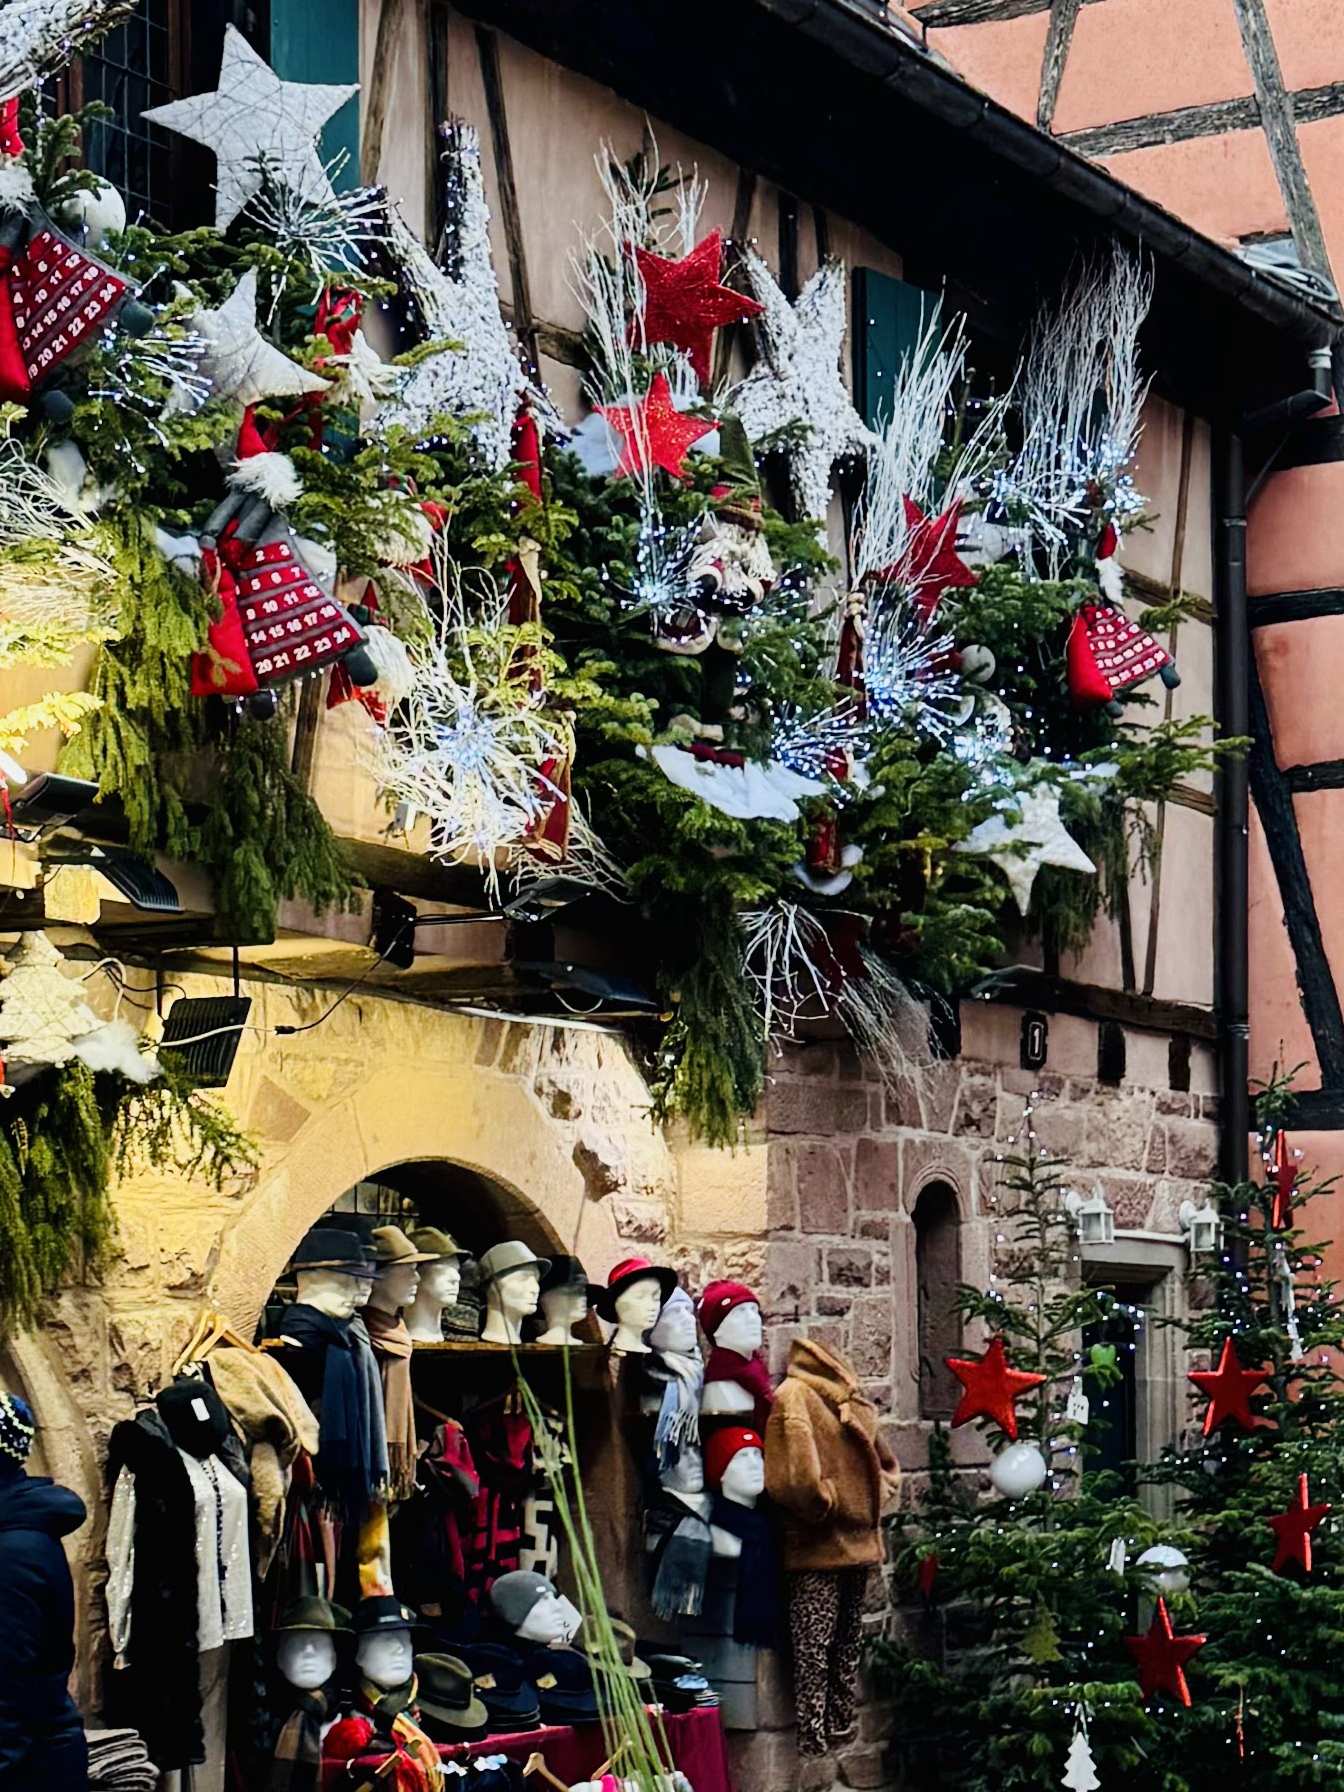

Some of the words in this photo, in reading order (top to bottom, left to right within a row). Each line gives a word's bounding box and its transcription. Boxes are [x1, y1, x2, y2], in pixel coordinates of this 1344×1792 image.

[31, 322, 44, 338] 14
[43, 309, 58, 326] 15
[70, 280, 83, 296] 17
[34, 288, 48, 304] 10
[37, 347, 54, 367] 20
[51, 334, 68, 353] 21
[67, 316, 86, 337] 22
[83, 300, 102, 320] 23
[99, 282, 117, 303] 24
[255, 550, 265, 562] 2
[279, 544, 290, 556] 3
[251, 578, 261, 591] 5
[290, 566, 301, 578] 7
[262, 600, 278, 613] 10
[284, 591, 299, 605] 11
[303, 585, 320, 598] 12
[250, 630, 267, 644] 14
[268, 624, 285, 638] 15
[286, 618, 302, 633] 16
[303, 612, 318, 626] 17
[255, 658, 273, 674] 20
[273, 652, 290, 668] 21
[293, 645, 312, 661] 22
[314, 637, 332, 653] 23
[333, 626, 351, 644] 24
